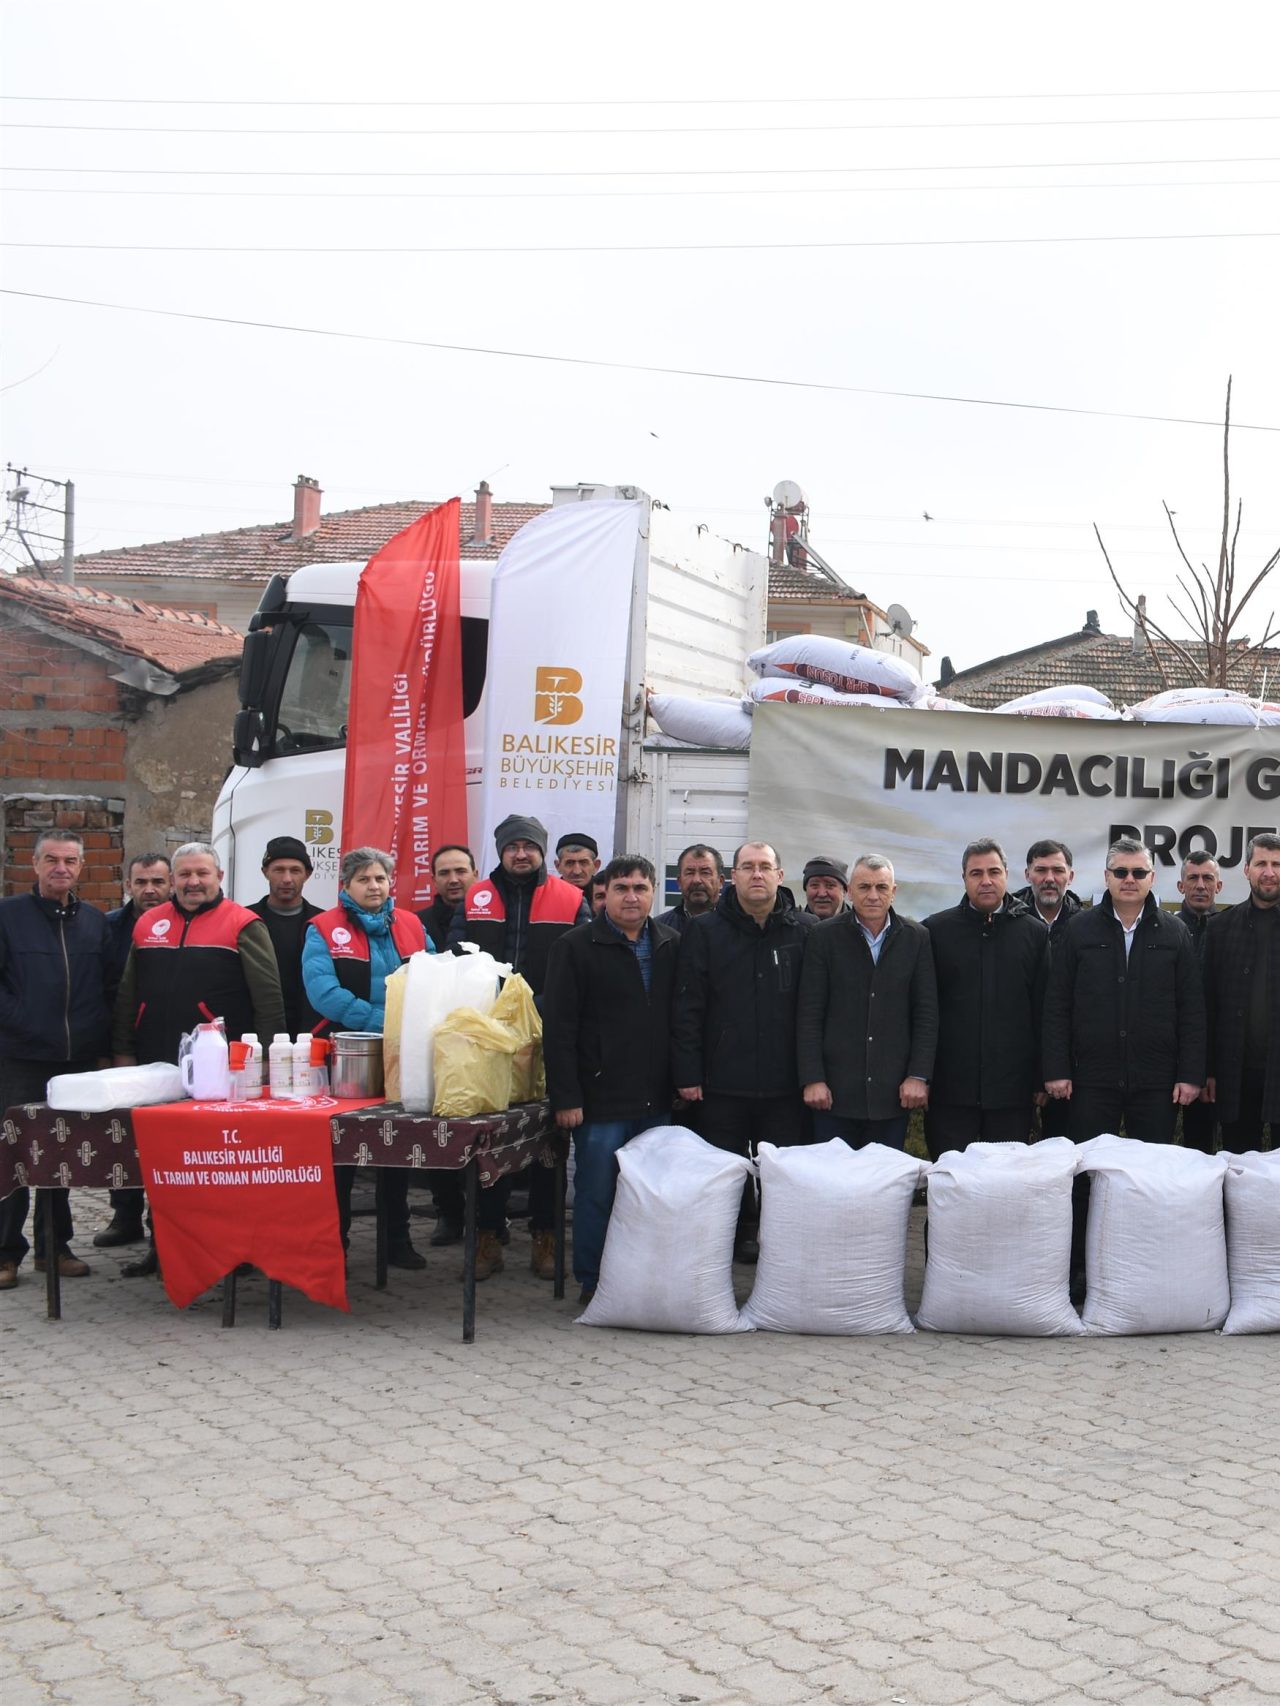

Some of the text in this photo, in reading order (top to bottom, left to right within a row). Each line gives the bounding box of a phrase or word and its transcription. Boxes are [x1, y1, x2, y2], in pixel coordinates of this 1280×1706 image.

[502, 733, 616, 756] BALIKESİR
[501, 755, 615, 778] BÜYÜKŞEHİR
[883, 747, 1230, 799] MANDACILIĞI
[412, 782, 428, 808] VE
[413, 815, 430, 877] TARIM
[412, 884, 431, 902] İL
[221, 1129, 242, 1143] T.C.
[183, 1146, 283, 1165] BALIKESİR VALİLİĞİ
[152, 1166, 322, 1185] İL TARIM VE ORMAN MÜDÜRLÜĞÜ
